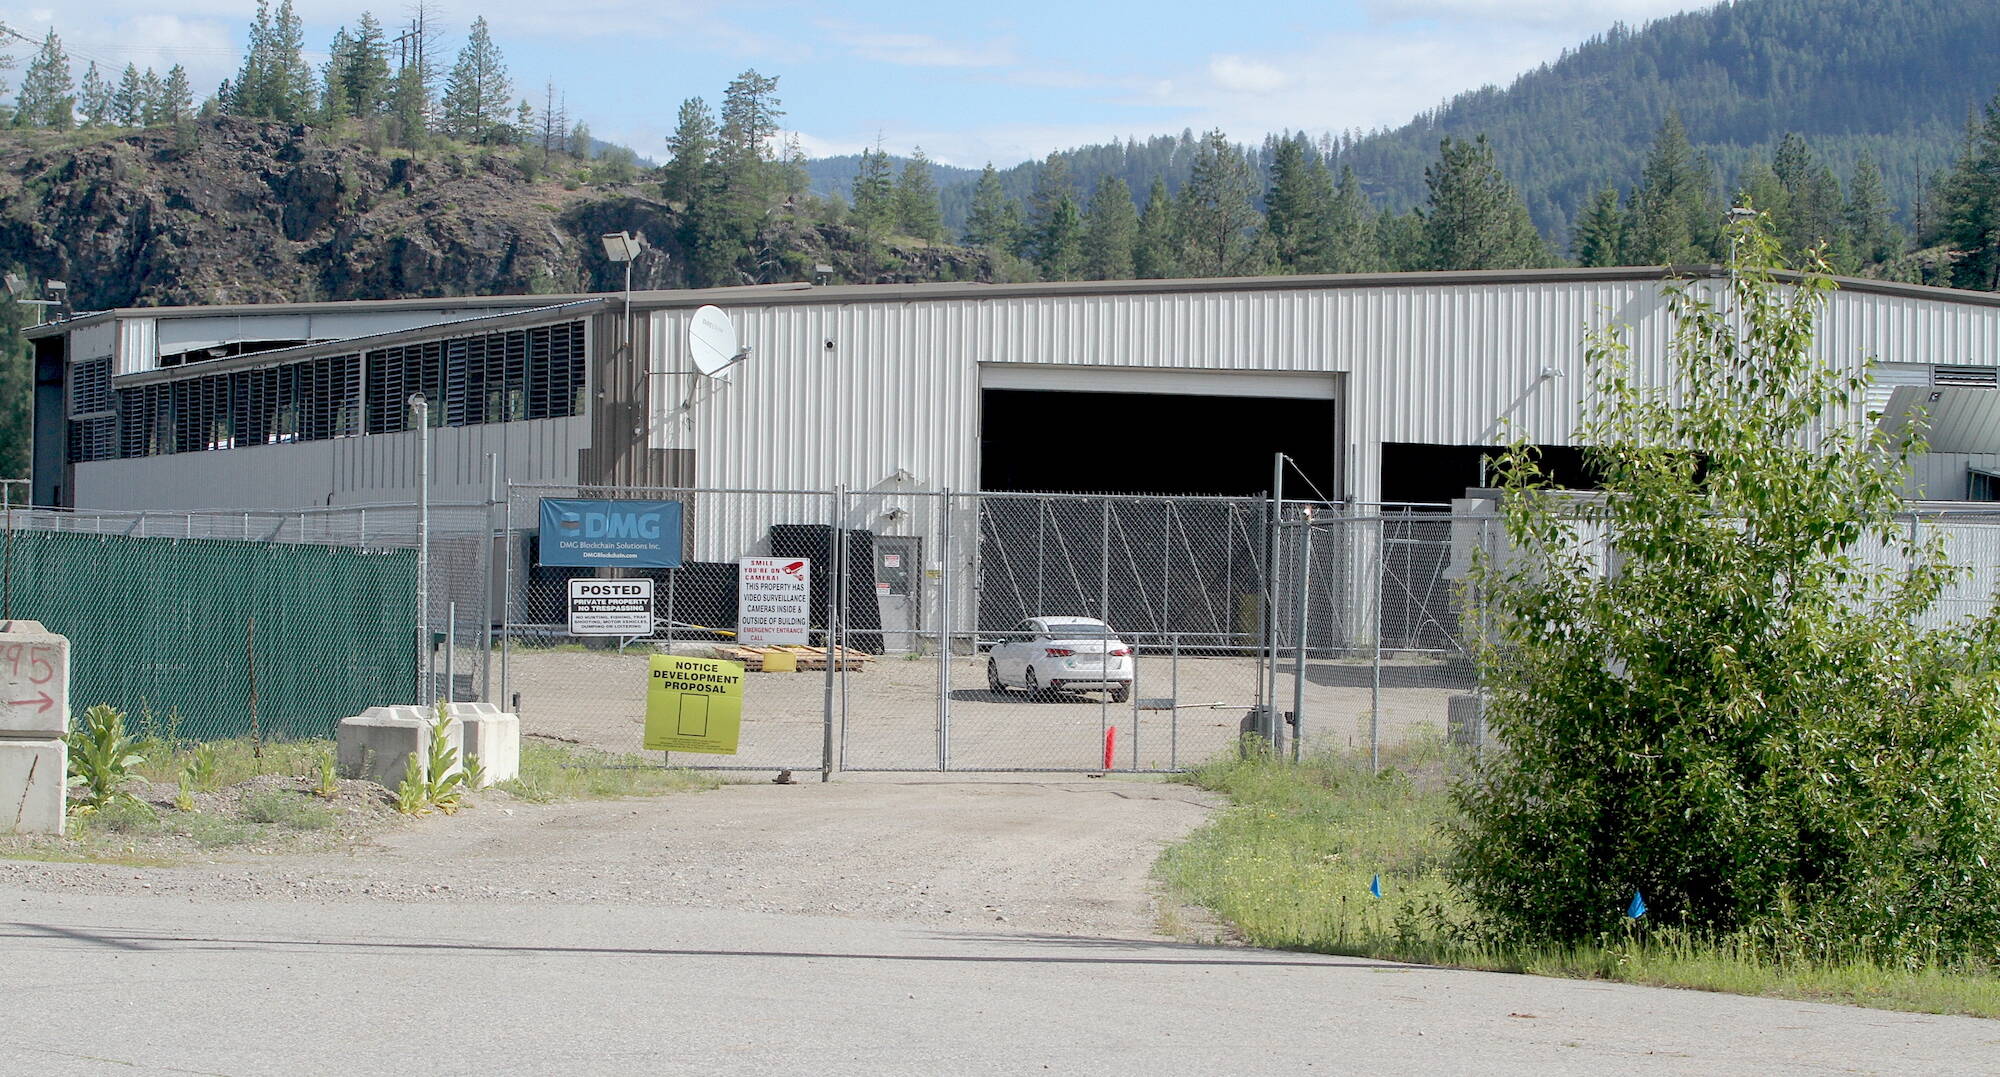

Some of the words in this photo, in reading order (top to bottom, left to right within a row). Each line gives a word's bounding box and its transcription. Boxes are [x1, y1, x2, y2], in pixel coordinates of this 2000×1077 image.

[585, 512, 660, 539] DMG
[560, 541, 579, 549] DMG
[580, 541, 615, 550] Blockchain
[616, 542, 648, 550] Solutions
[649, 542, 661, 550] Inc.
[581, 585, 642, 595] POSTED
[746, 582, 760, 591] THIS
[760, 583, 791, 591] PROPERTY
[792, 583, 805, 591] HAS
[744, 593, 762, 601] VIDEO
[762, 594, 806, 602] SURVEILLANCE
[747, 604, 776, 613] CAMERAS
[776, 605, 796, 613] INSIDE
[797, 605, 802, 613] &
[742, 616, 768, 625] OUTSIDE
[768, 617, 777, 625] OF
[778, 617, 806, 625] BUILDING
[0, 644, 54, 684] 95
[675, 661, 719, 672] NOTICE
[653, 670, 739, 684] DEVELOPMENT
[664, 681, 726, 694] PROPOSAL
